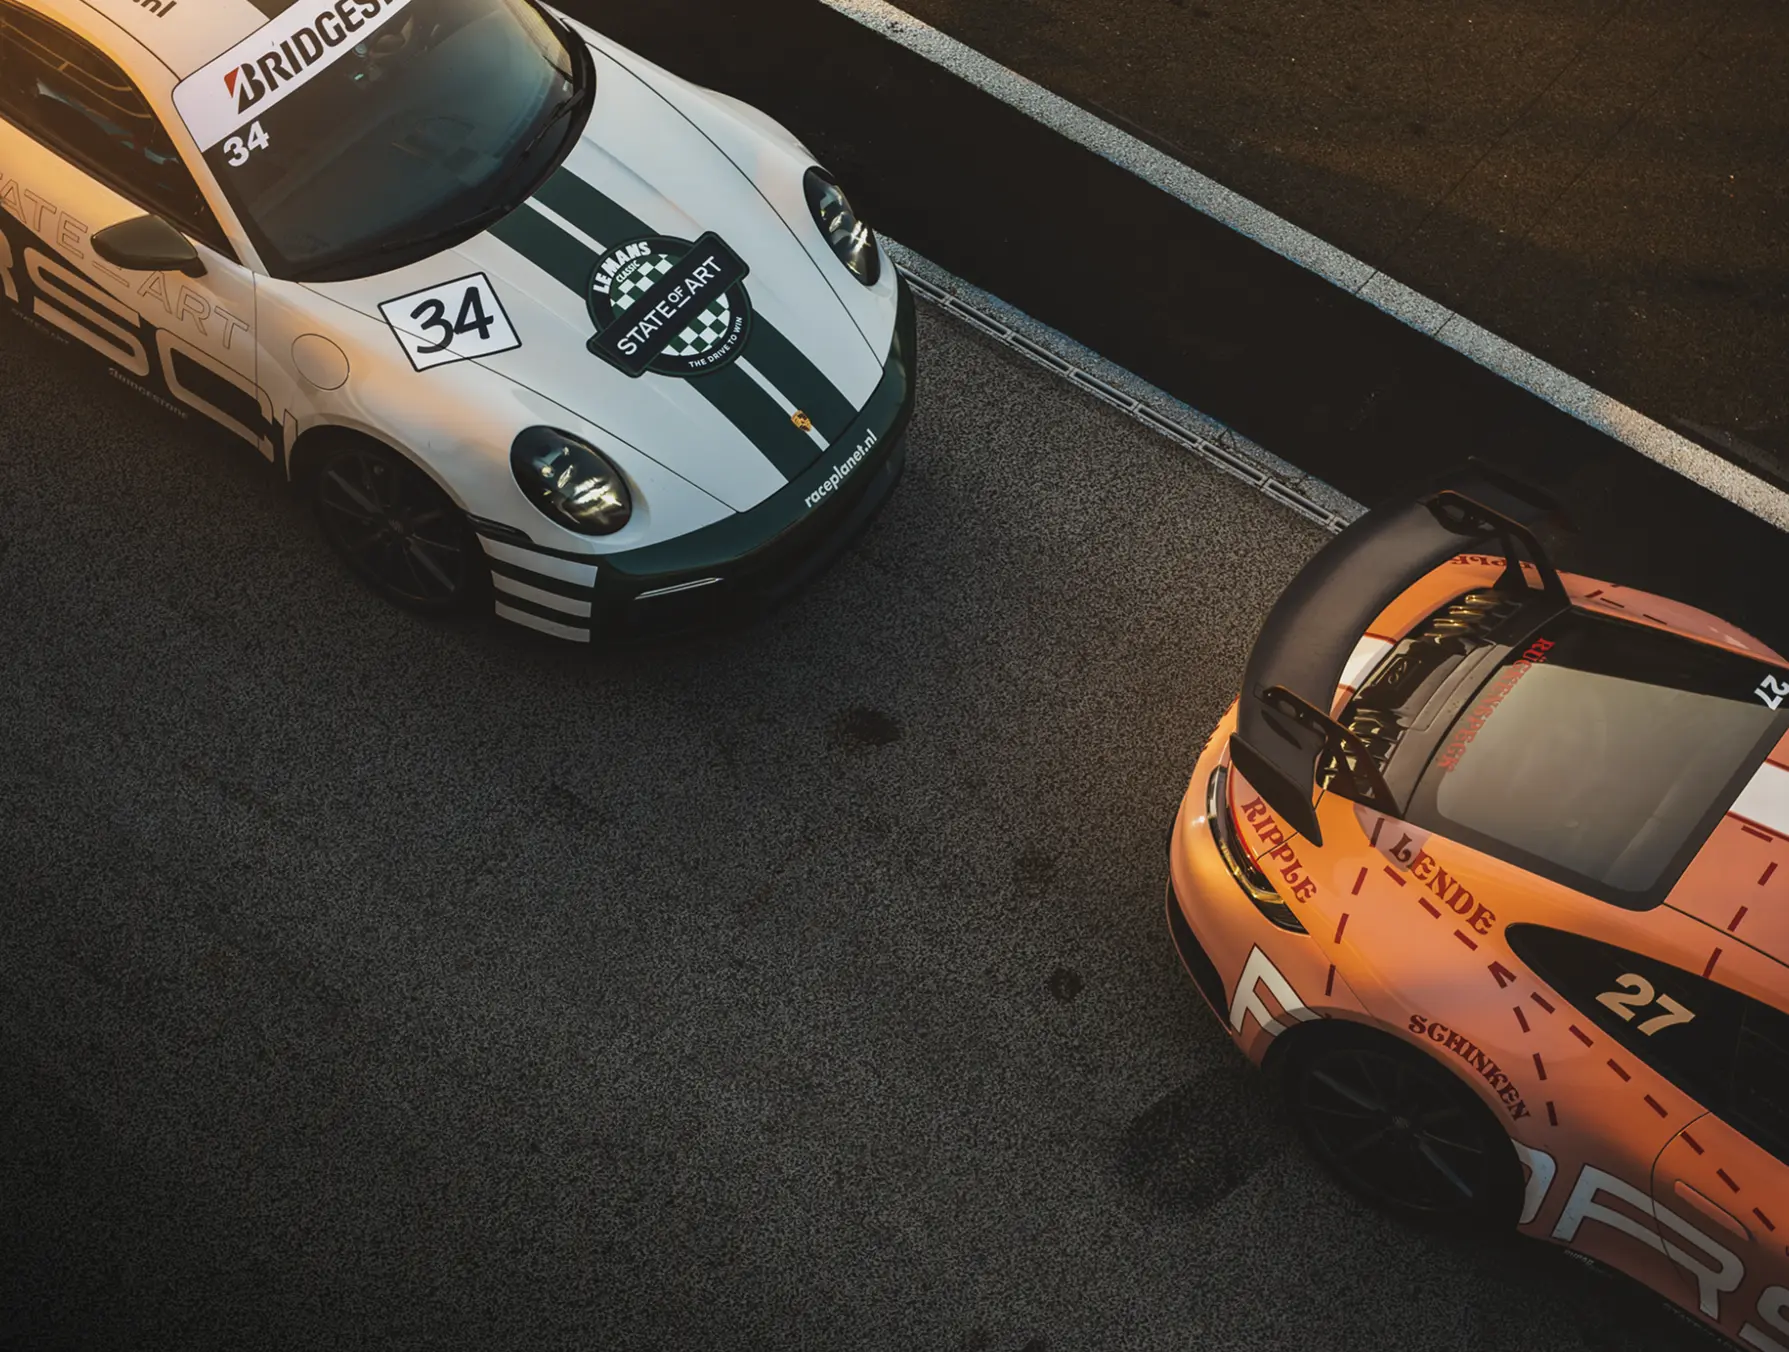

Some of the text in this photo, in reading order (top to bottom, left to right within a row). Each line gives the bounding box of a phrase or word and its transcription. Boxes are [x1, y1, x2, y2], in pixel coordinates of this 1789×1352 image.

[223, 0, 398, 115] BRIDGES
[223, 120, 270, 167] 34
[592, 241, 652, 294] LE MANS
[616, 260, 641, 283] CLASSIC
[137, 269, 250, 350] ART
[409, 286, 494, 354] 34
[617, 256, 721, 355] STATE OF ART
[688, 316, 743, 368] THE DRIVE TO WIN
[804, 428, 878, 508] raceplanet.nl
[1753, 673, 1789, 711] 27
[1240, 796, 1318, 904] RIPPLE
[1389, 832, 1497, 936] LENDE
[1595, 972, 1697, 1037] 27
[1408, 1013, 1532, 1122] SCHINKEN
